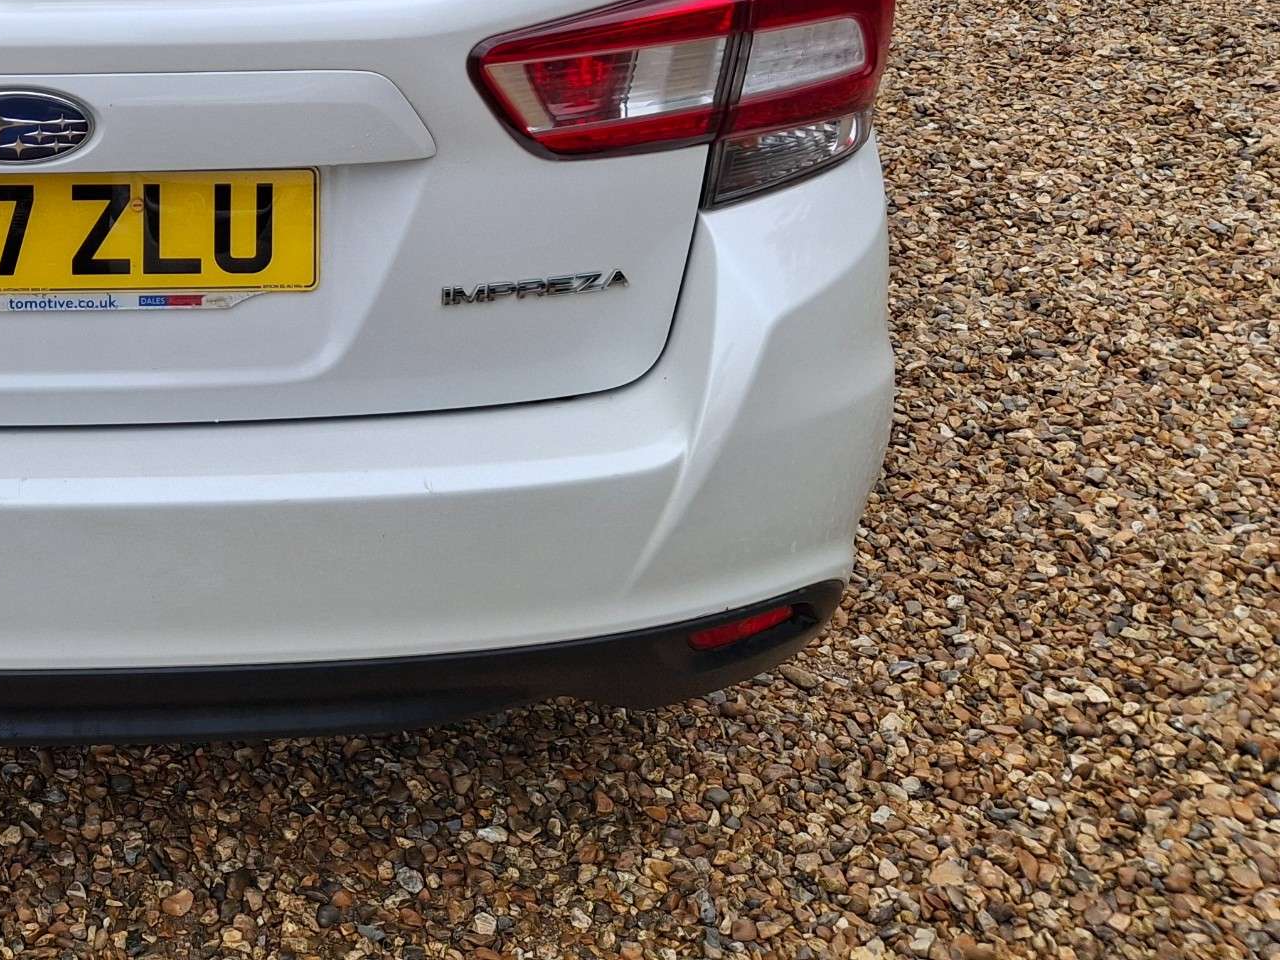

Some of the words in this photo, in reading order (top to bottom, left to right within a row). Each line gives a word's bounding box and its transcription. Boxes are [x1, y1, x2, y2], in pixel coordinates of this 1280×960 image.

[71, 183, 274, 276] ZLU
[440, 267, 631, 306] IMPREZA
[8, 294, 117, 310] tomotive.co.uk
[140, 297, 166, 305] DALES
